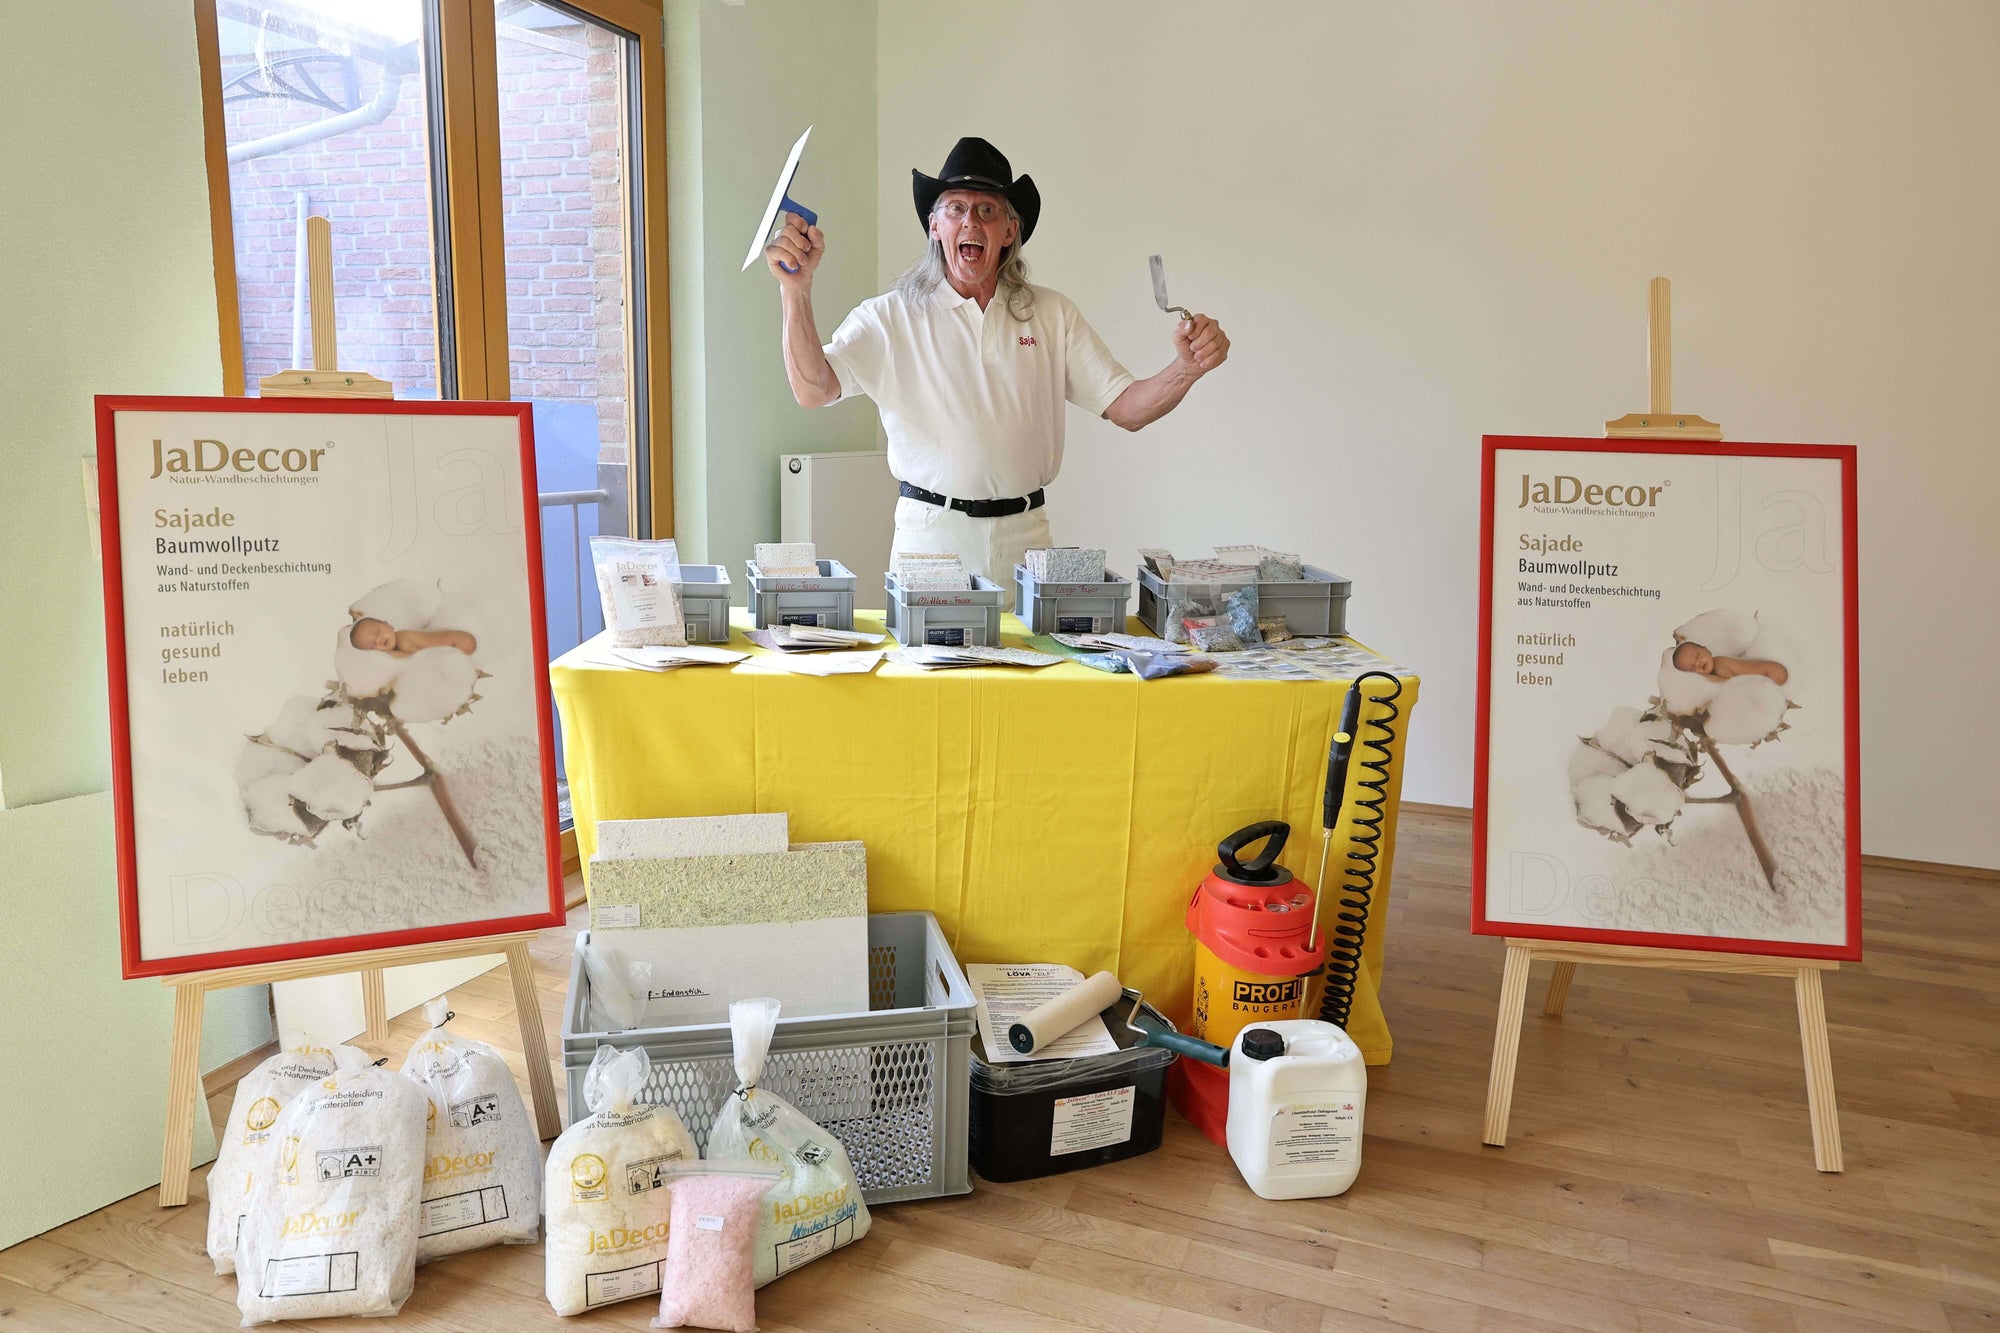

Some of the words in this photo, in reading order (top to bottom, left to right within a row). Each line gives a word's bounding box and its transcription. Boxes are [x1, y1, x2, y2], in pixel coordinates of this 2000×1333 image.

[169, 474, 319, 485] Natur-Wandbeschichtungen
[1533, 505, 1656, 519] Natur-Wandbeschichtungen
[154, 506, 236, 534] Sajade
[155, 535, 280, 556] Baumwollputz
[1519, 533, 1584, 556] Sajade
[156, 564, 194, 576] Wand-
[197, 563, 218, 575] und
[221, 561, 332, 575] Deckenbeschichtung
[616, 561, 658, 573] JaDecor
[1519, 558, 1618, 579] Baumwollputz
[157, 584, 177, 592] aus
[180, 578, 250, 592] Naturstoffen
[1517, 581, 1547, 592] Wand-
[1549, 583, 1567, 594] und
[1569, 584, 1661, 600] Deckenbeschichtung
[1517, 597, 1533, 606] aus
[1535, 596, 1591, 609] Naturstoffen
[160, 620, 235, 638] natürlich
[1517, 632, 1576, 647] natürlich
[161, 642, 221, 664] gesund
[1517, 652, 1564, 667] gesund
[163, 668, 209, 684] leben
[1516, 671, 1553, 686] leben
[298, 1065, 331, 1076] Deckenb
[473, 1102, 496, 1119] A+
[346, 1154, 377, 1168] A+
[424, 1151, 496, 1179] aDecor
[586, 1222, 669, 1255] JaDeco
